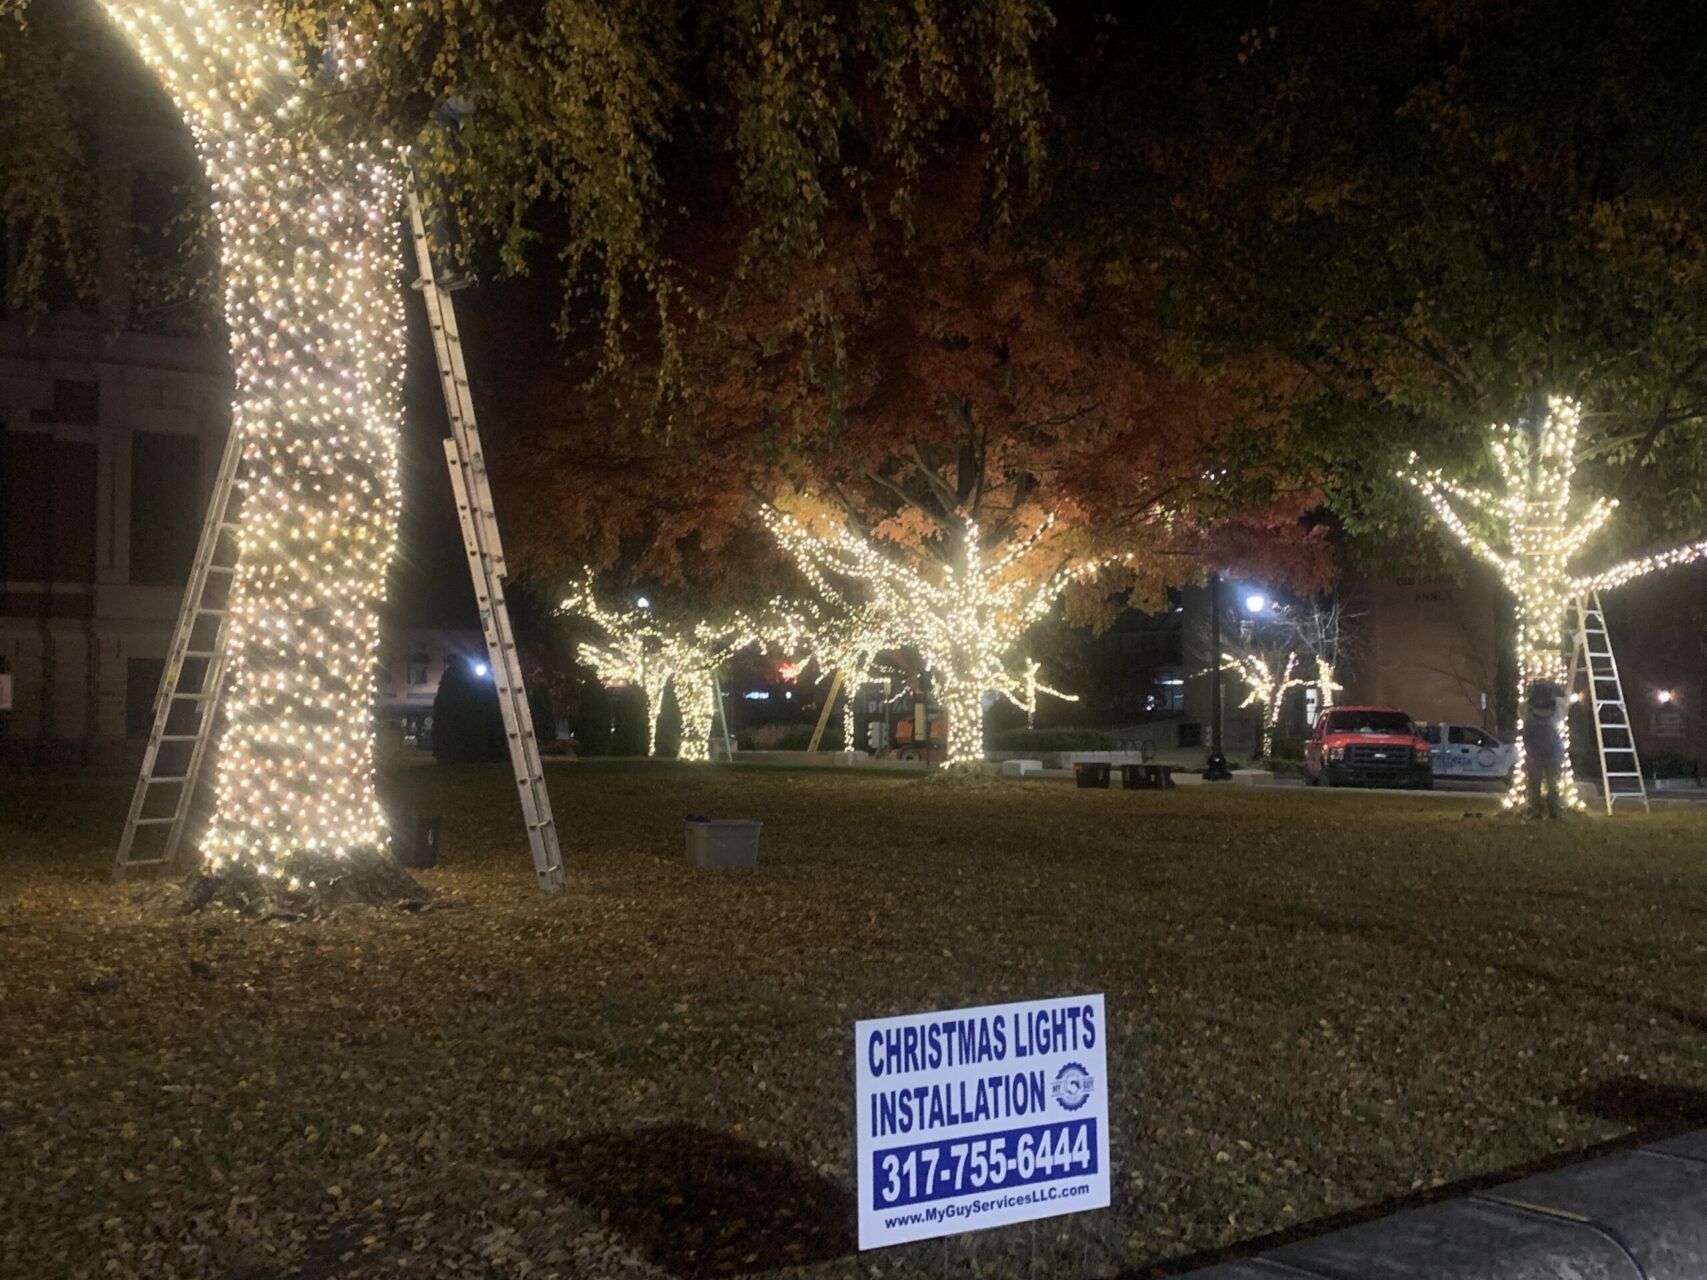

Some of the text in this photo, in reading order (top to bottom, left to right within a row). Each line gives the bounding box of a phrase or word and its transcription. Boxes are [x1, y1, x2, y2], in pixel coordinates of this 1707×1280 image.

[868, 1004, 1096, 1078] CHRISTMAS LIGHTS
[870, 1069, 1046, 1138] INSTALLATION
[881, 1124, 1091, 1203] 317-755-6444
[884, 1184, 1090, 1229] www.MyGuyServicesLLC.com
